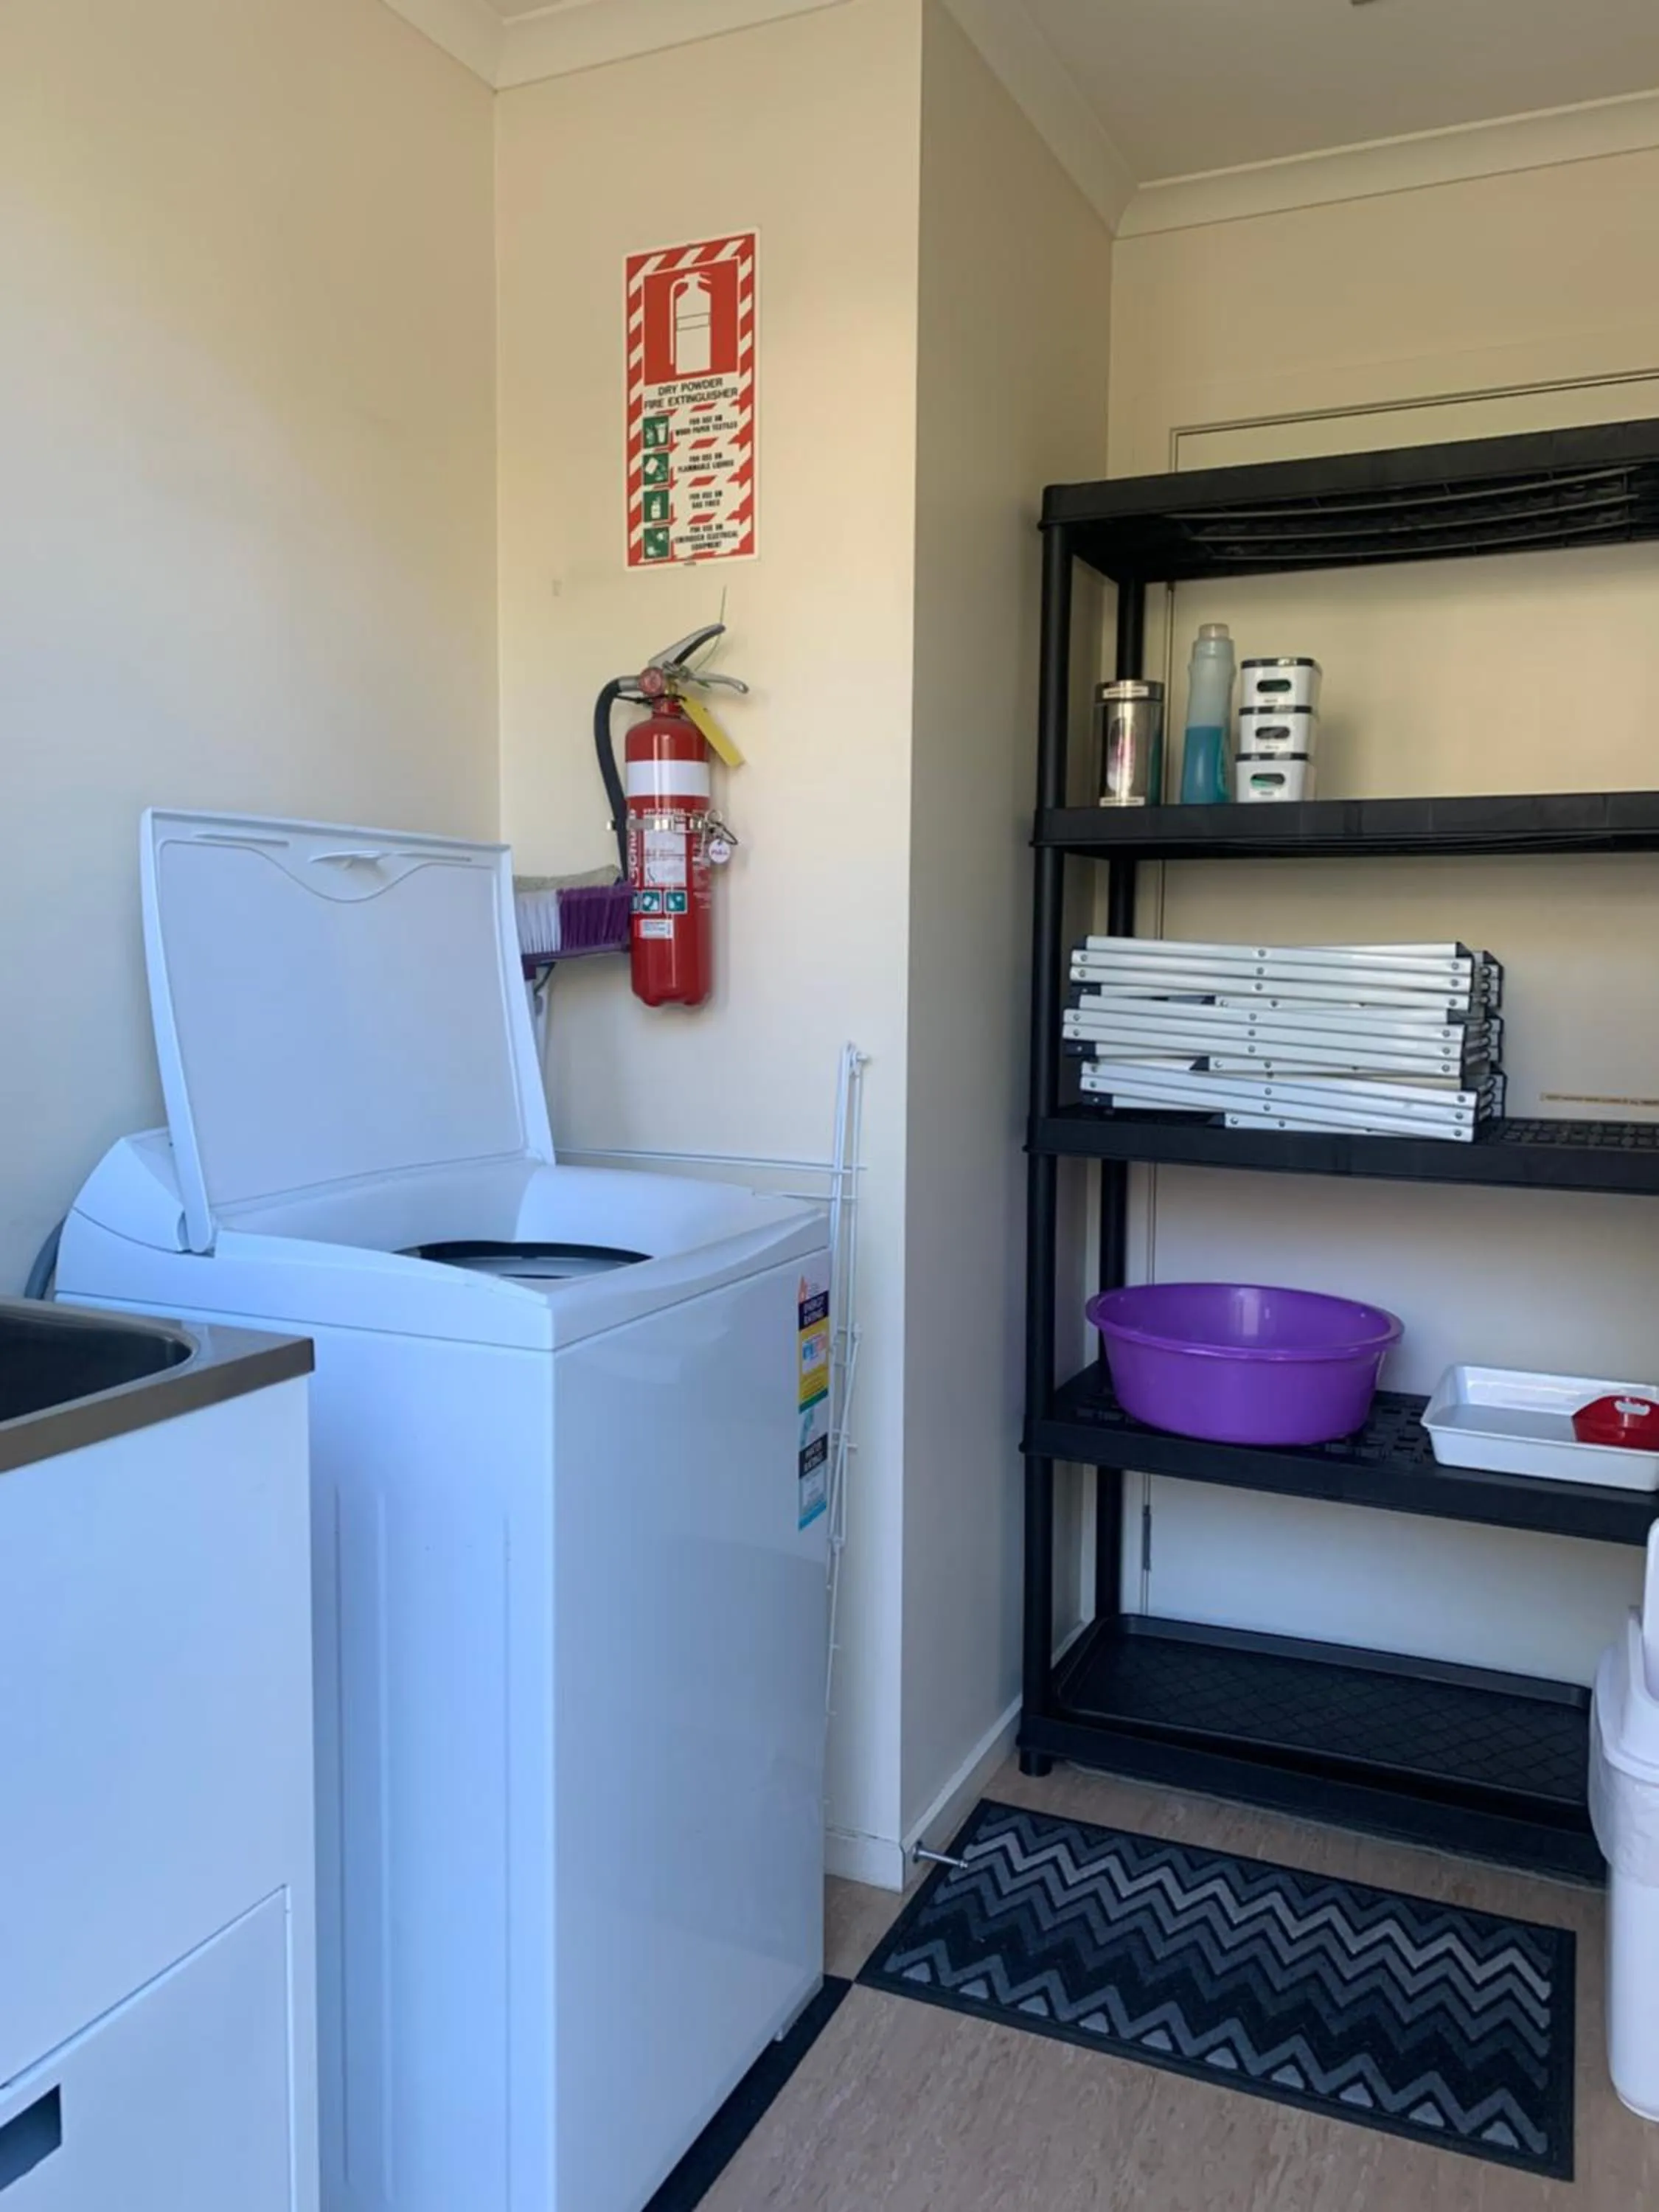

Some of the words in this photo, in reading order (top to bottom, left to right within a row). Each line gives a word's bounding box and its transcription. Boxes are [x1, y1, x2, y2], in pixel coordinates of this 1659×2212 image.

[658, 385, 678, 396] DRY
[681, 378, 723, 391] POWDER
[644, 399, 663, 409] FIRE
[668, 387, 737, 406] EXTINGUISHER
